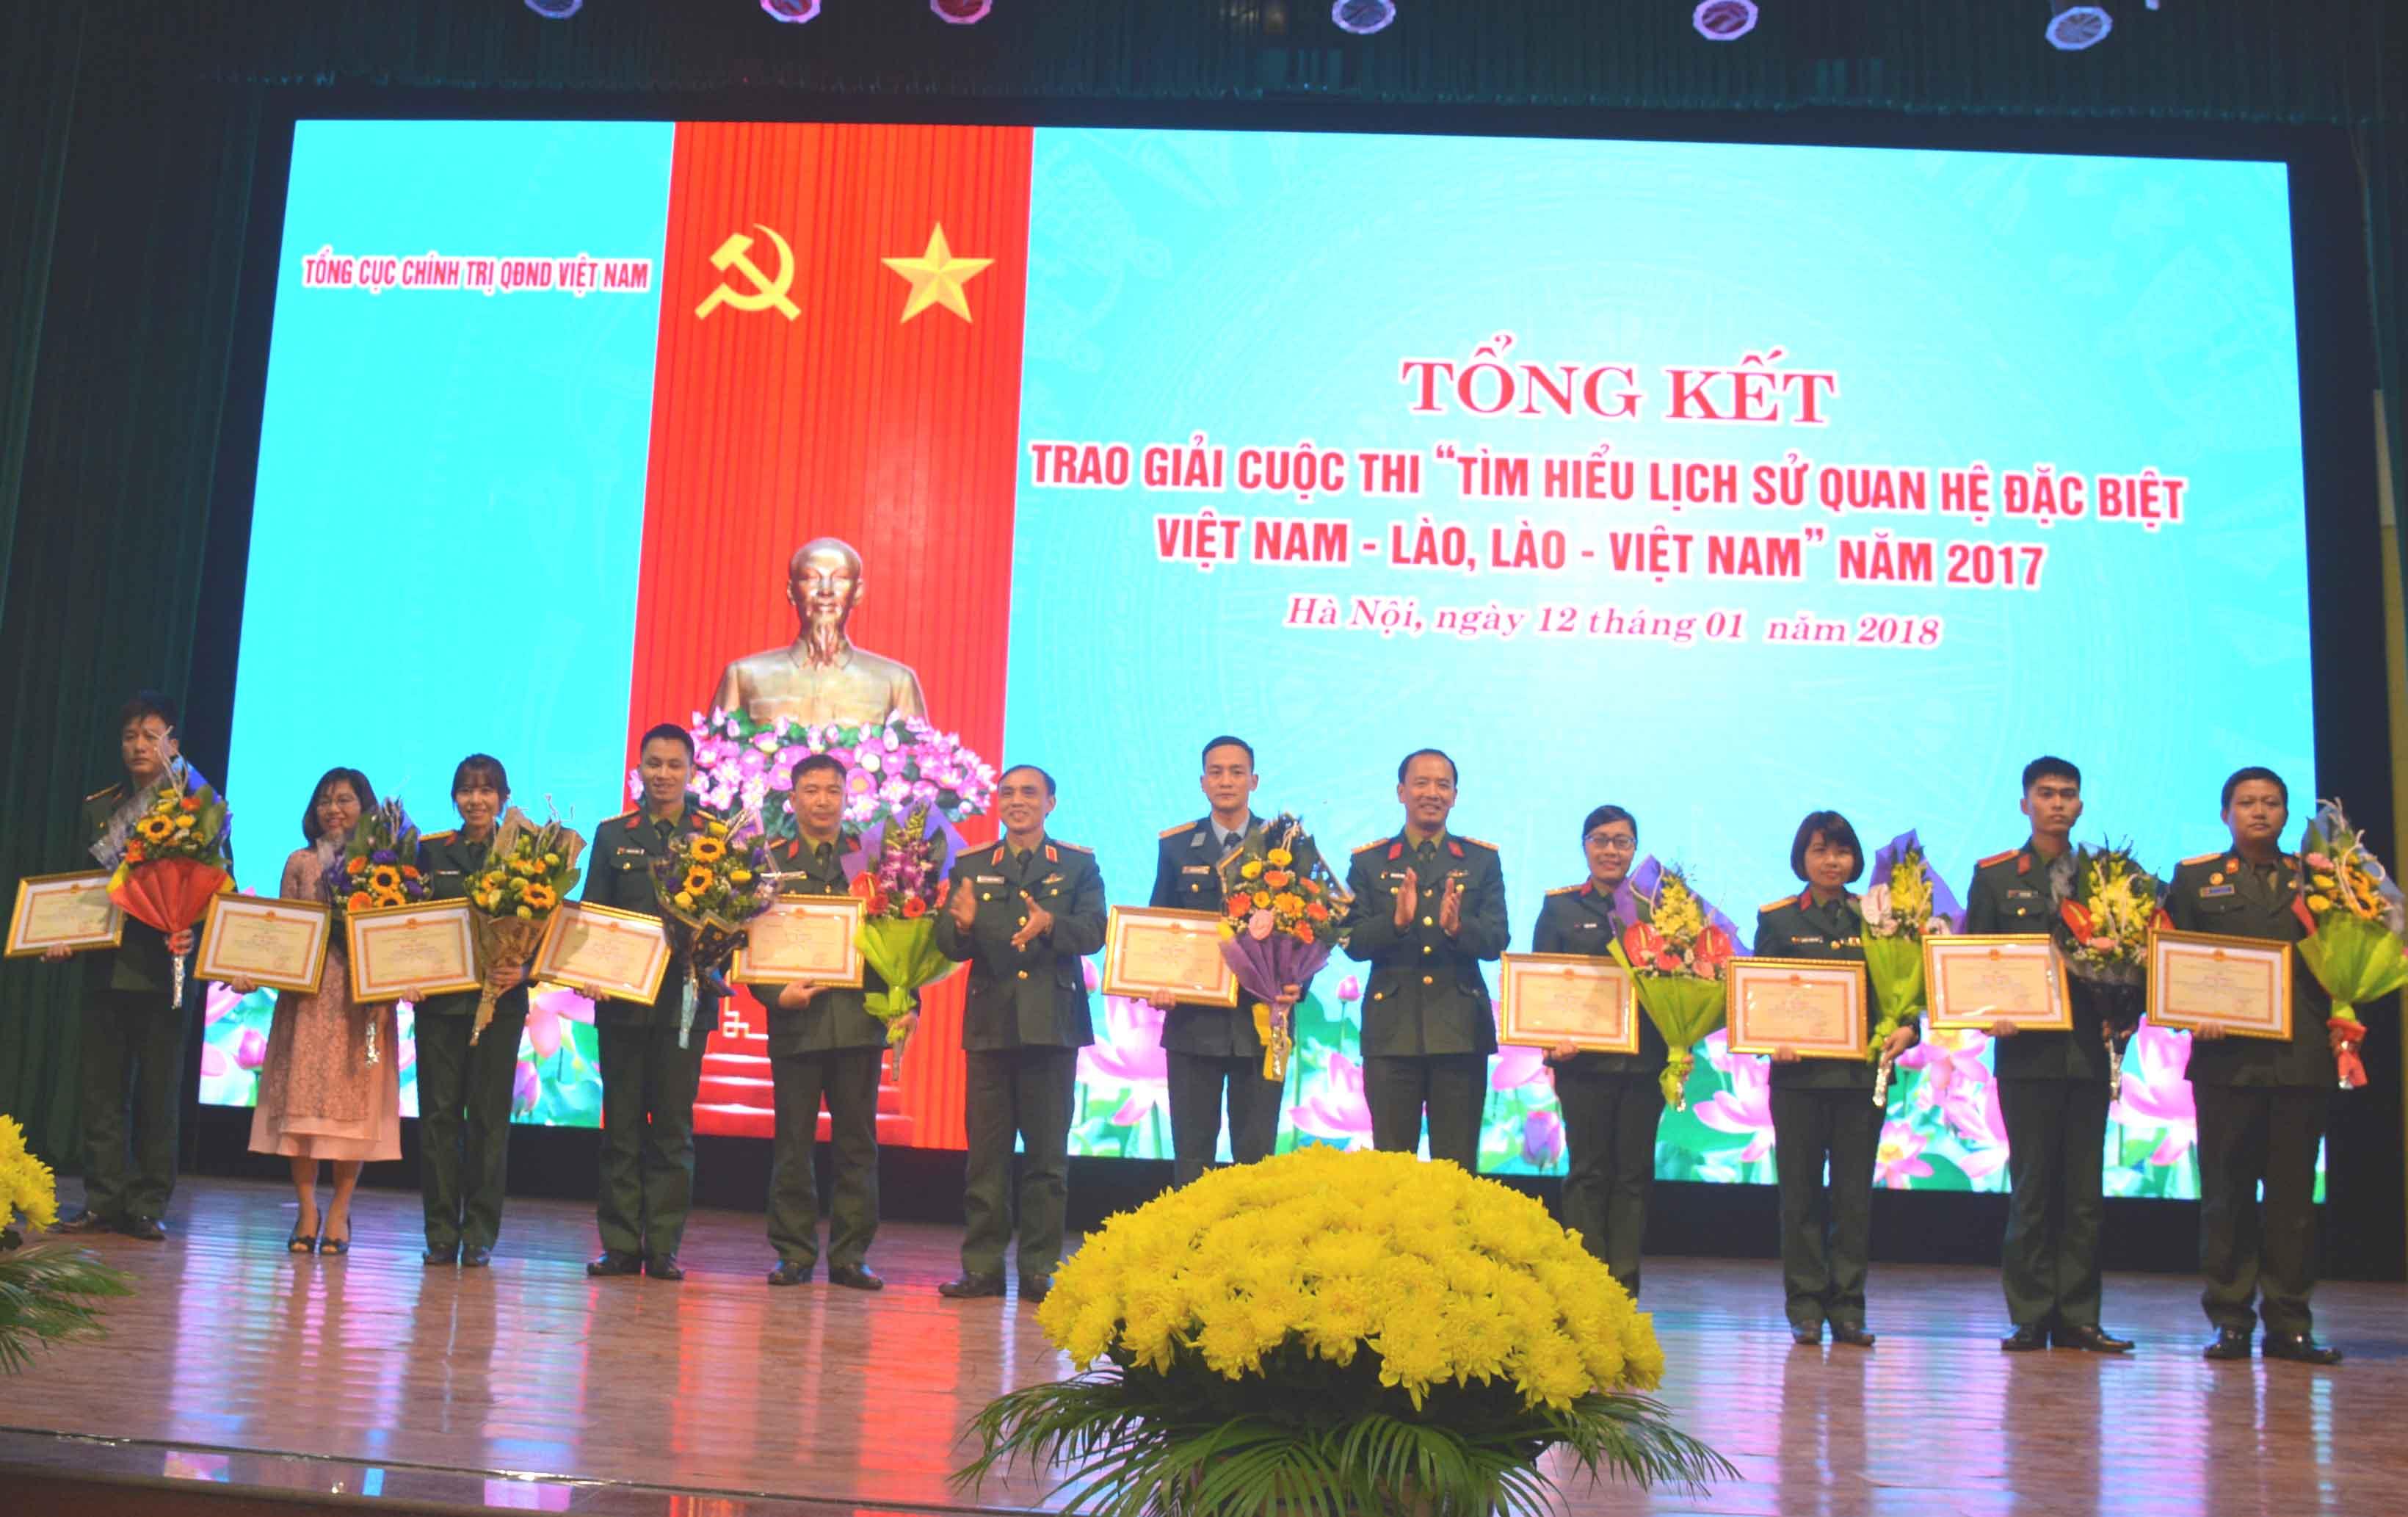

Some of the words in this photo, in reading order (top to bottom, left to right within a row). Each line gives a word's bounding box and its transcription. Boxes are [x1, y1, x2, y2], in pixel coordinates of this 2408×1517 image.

[359, 259, 396, 290] CỤC
[402, 254, 460, 286] CHÍNH
[467, 260, 494, 292] TRỊ
[500, 261, 552, 289] QĐND
[559, 256, 598, 293] VIỆT
[603, 261, 648, 288] NAM
[1402, 334, 1642, 417] TỔNG
[1665, 350, 1835, 424] KẾT
[1031, 444, 1129, 485] TRAO
[1145, 435, 1222, 488] GIẢI
[1238, 443, 1344, 499] CUỘC
[1358, 453, 1419, 493] THI
[1545, 444, 1634, 501] HIỂU
[1650, 461, 1737, 511] LỊCH
[1752, 453, 1809, 507] SỬ
[1820, 467, 1926, 513] QUAN
[1941, 465, 1990, 522] HỆ
[2003, 467, 2084, 524] ĐẶC
[2098, 471, 2184, 529] BIỆT
[1158, 511, 1241, 569] VIỆT
[1254, 521, 1348, 562] NAM
[1392, 517, 1476, 571] LÀO,
[1492, 520, 1565, 570] LÀO
[1609, 525, 1694, 582] VIỆT
[1839, 533, 1932, 582] NĂM
[1947, 543, 2043, 585] 2017
[1286, 598, 1338, 627] Hà
[1350, 600, 1422, 634] Nội,
[1437, 605, 1523, 635] ngày
[1538, 608, 1577, 633] 12
[1589, 608, 1696, 642] tháng
[1705, 613, 1742, 640] 01
[1767, 617, 1847, 642] năm
[1857, 617, 1940, 645] 2018
